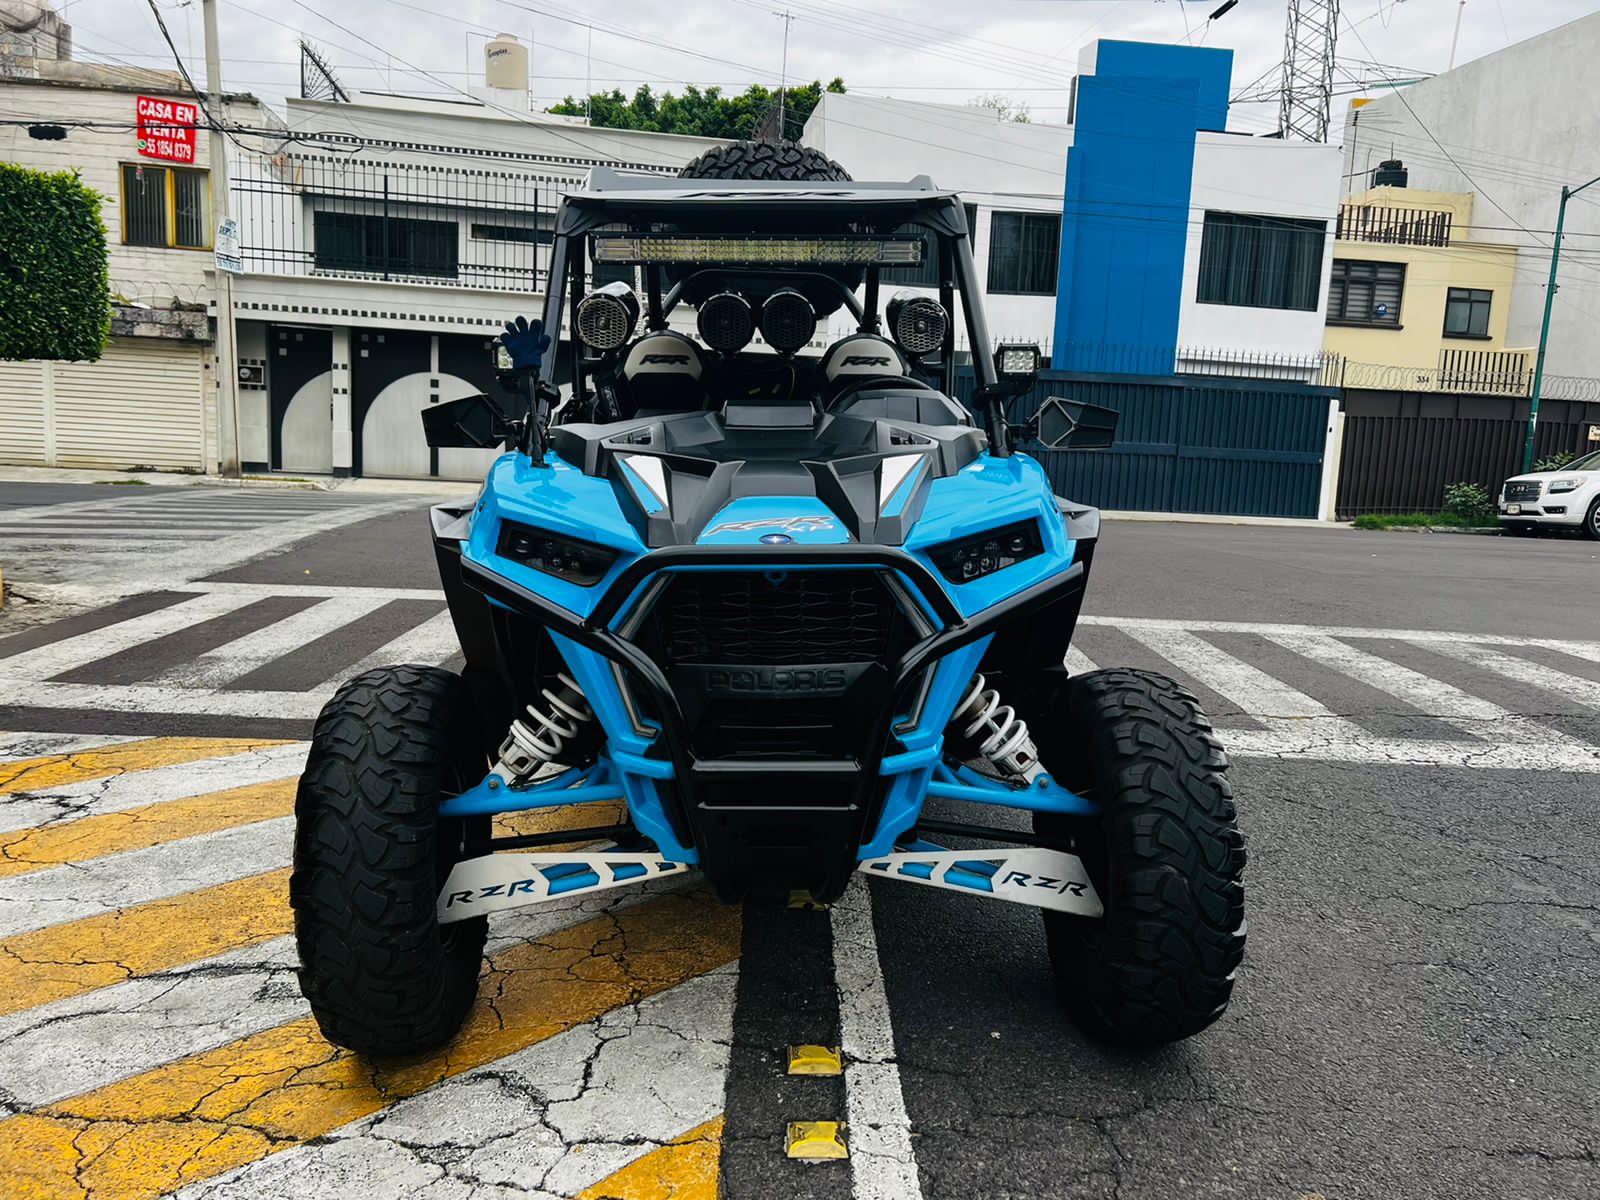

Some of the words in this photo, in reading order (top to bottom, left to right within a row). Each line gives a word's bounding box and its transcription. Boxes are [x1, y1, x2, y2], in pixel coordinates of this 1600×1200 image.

[139, 99, 173, 120] CASA
[176, 105, 194, 123] EN
[144, 118, 186, 140] VENTA
[147, 138, 156, 154] 55
[639, 354, 691, 366] RZR
[840, 356, 890, 367] RZR
[705, 669, 849, 694] POLARIS
[446, 879, 535, 909] RZR
[1001, 870, 1088, 897] RZR
